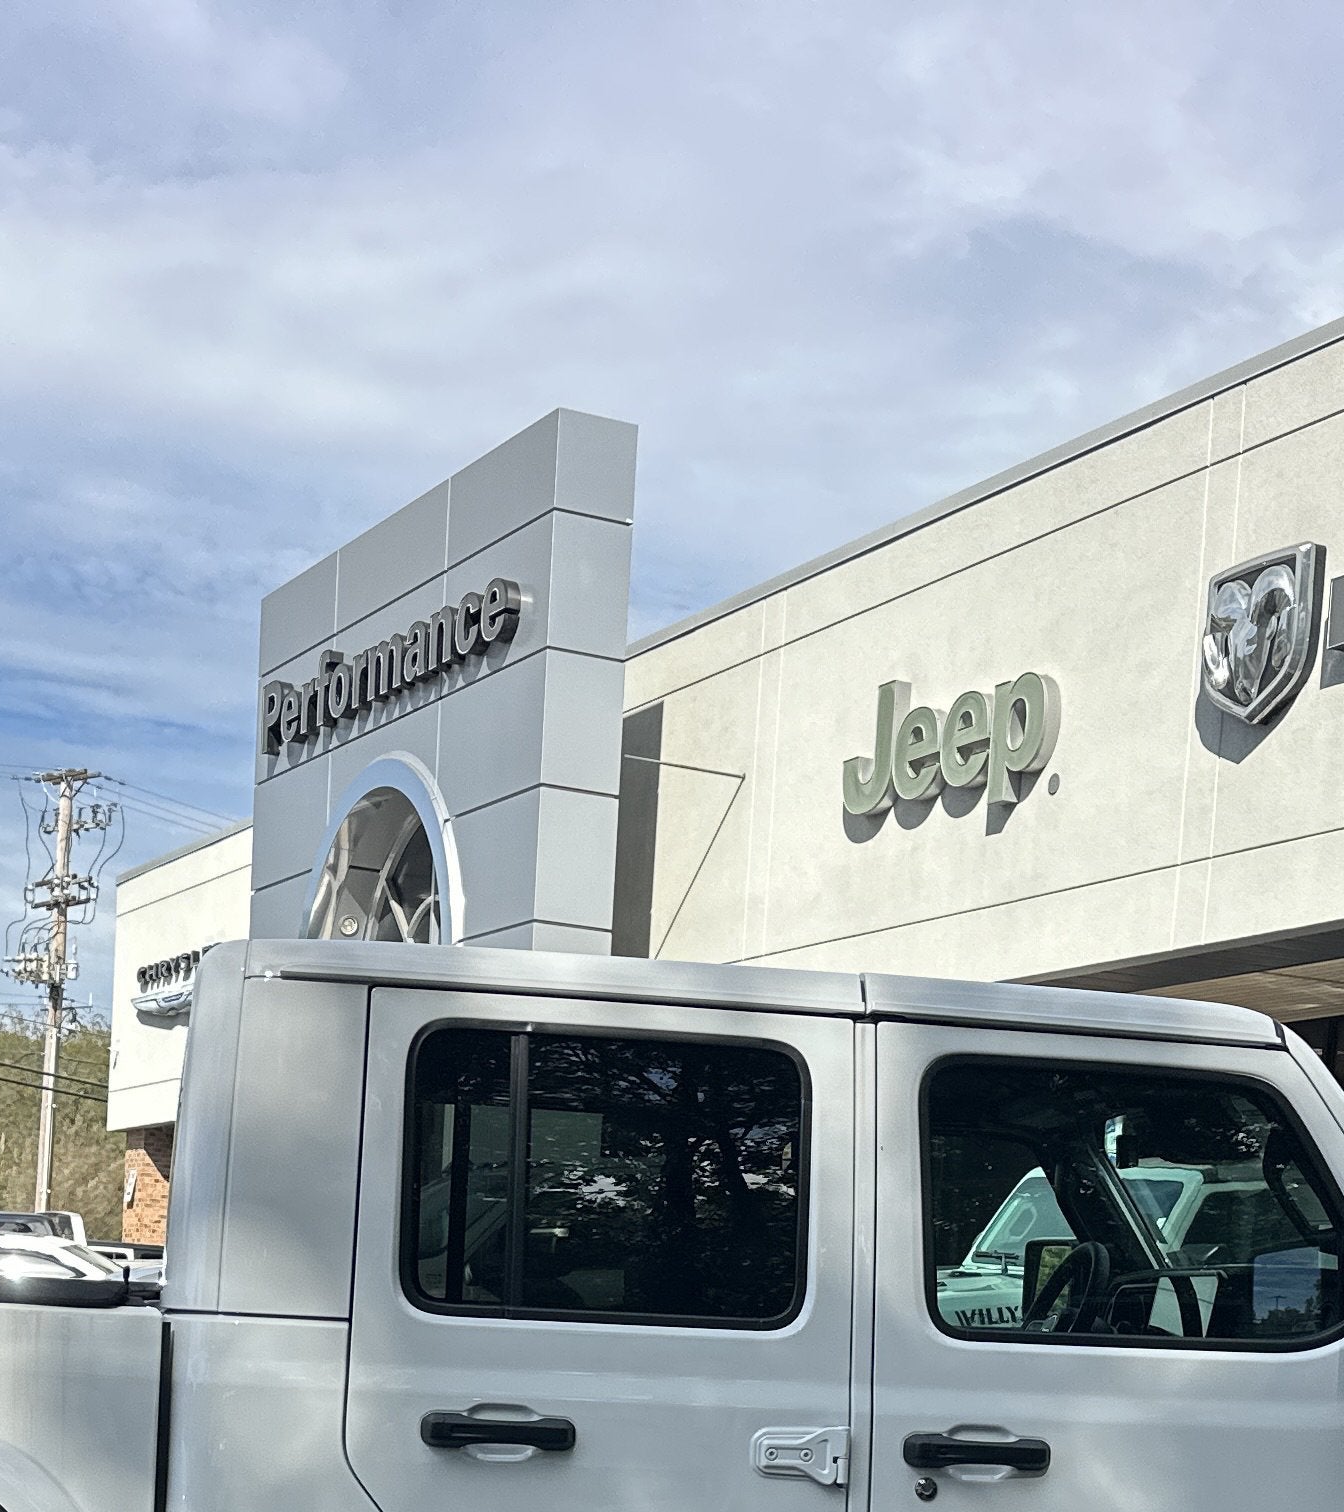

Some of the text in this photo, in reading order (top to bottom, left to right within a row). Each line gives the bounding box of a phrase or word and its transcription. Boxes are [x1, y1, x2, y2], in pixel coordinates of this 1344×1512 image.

[263, 577, 521, 755] Performance
[843, 672, 1061, 814] Jeep
[137, 943, 222, 983] CHRYSL
[954, 1305, 1023, 1328] WILLY
